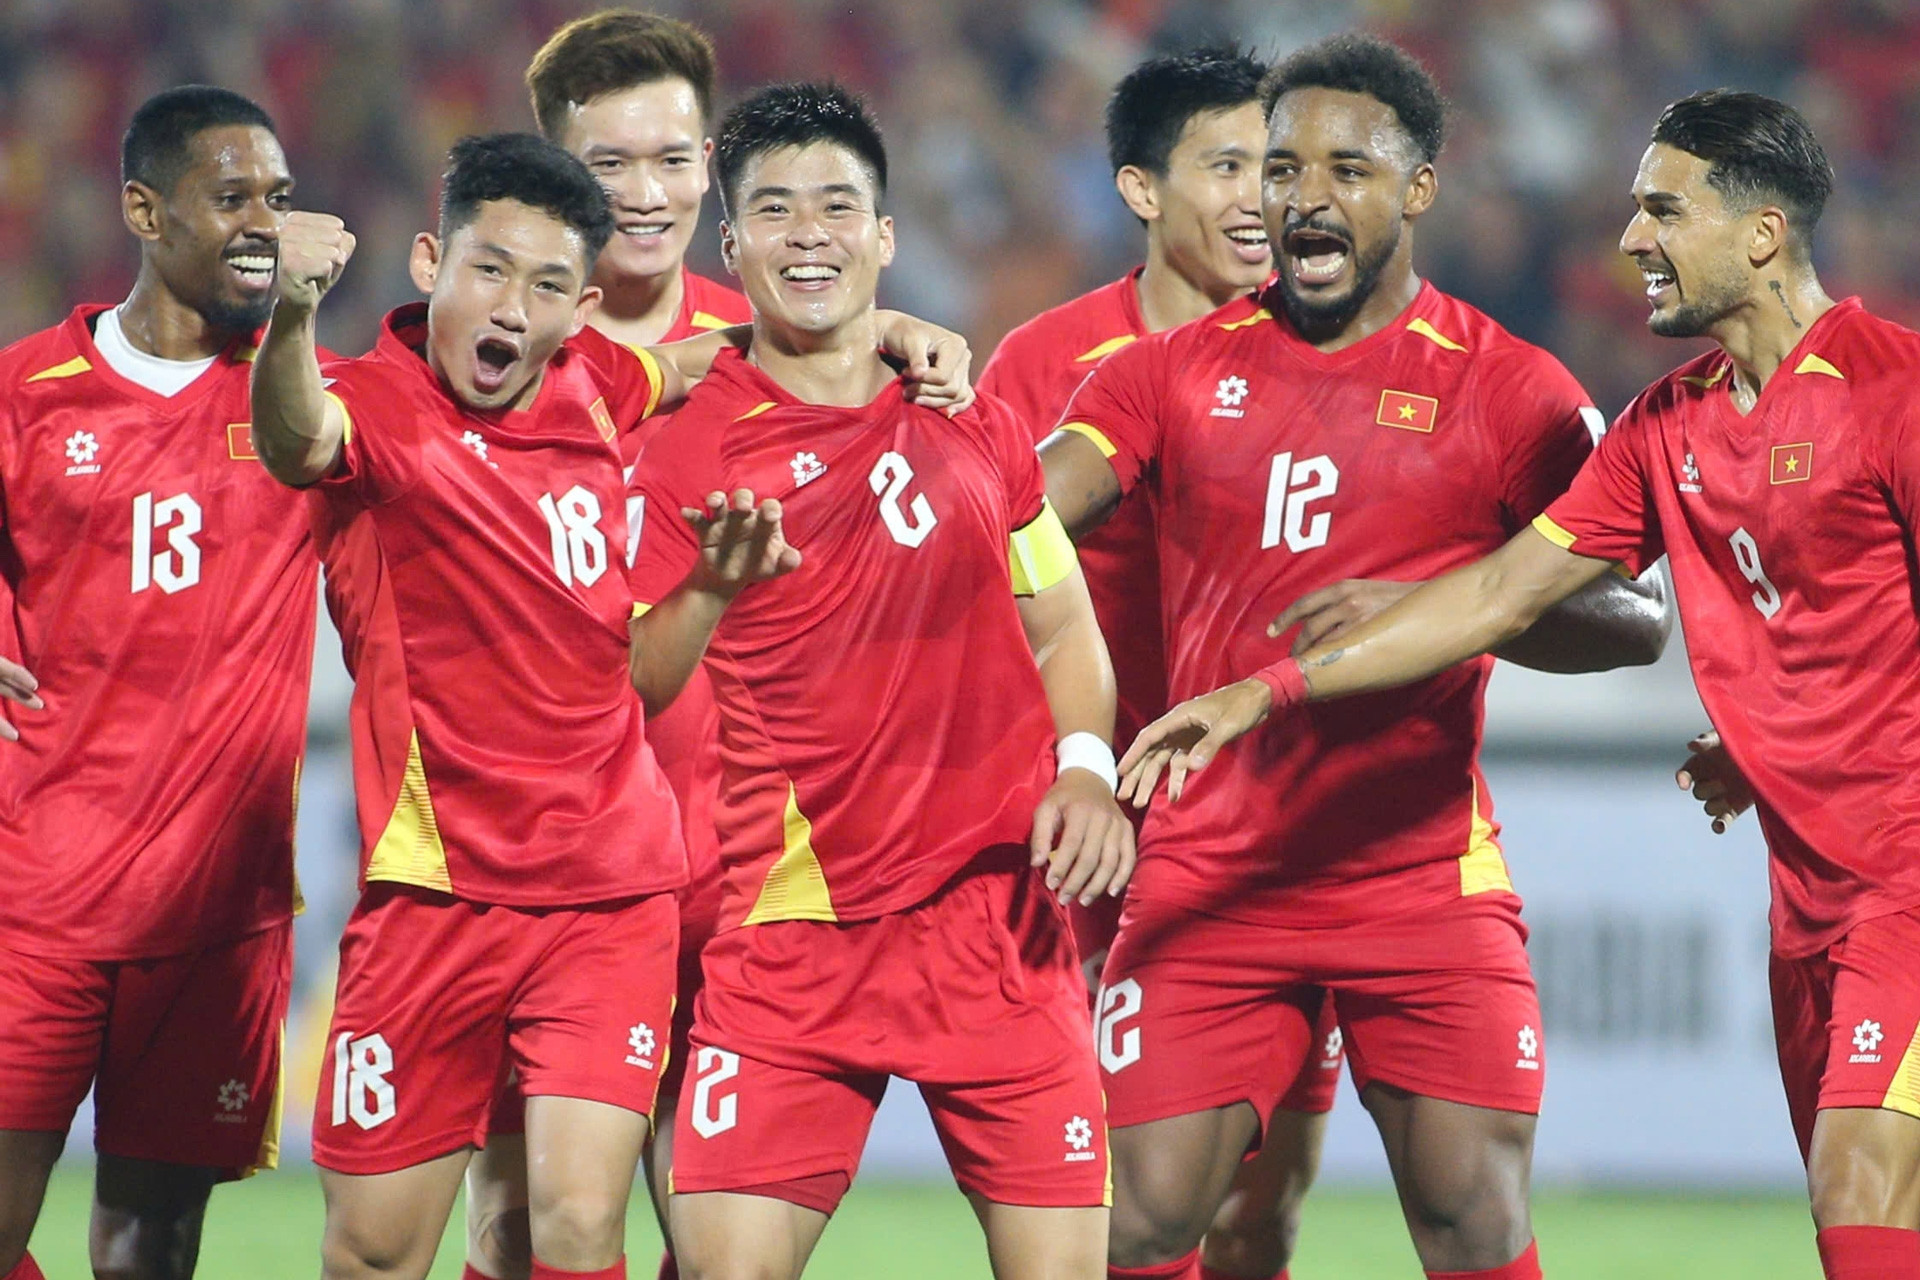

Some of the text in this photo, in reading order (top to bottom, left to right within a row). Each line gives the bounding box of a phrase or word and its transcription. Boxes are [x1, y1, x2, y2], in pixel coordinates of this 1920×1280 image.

[131, 491, 202, 594] 13
[537, 484, 608, 589] 18
[868, 451, 938, 548] 2
[1260, 451, 1339, 554] 12
[1729, 526, 1782, 622] 9
[331, 1031, 396, 1130] 18
[690, 1046, 740, 1140] 2
